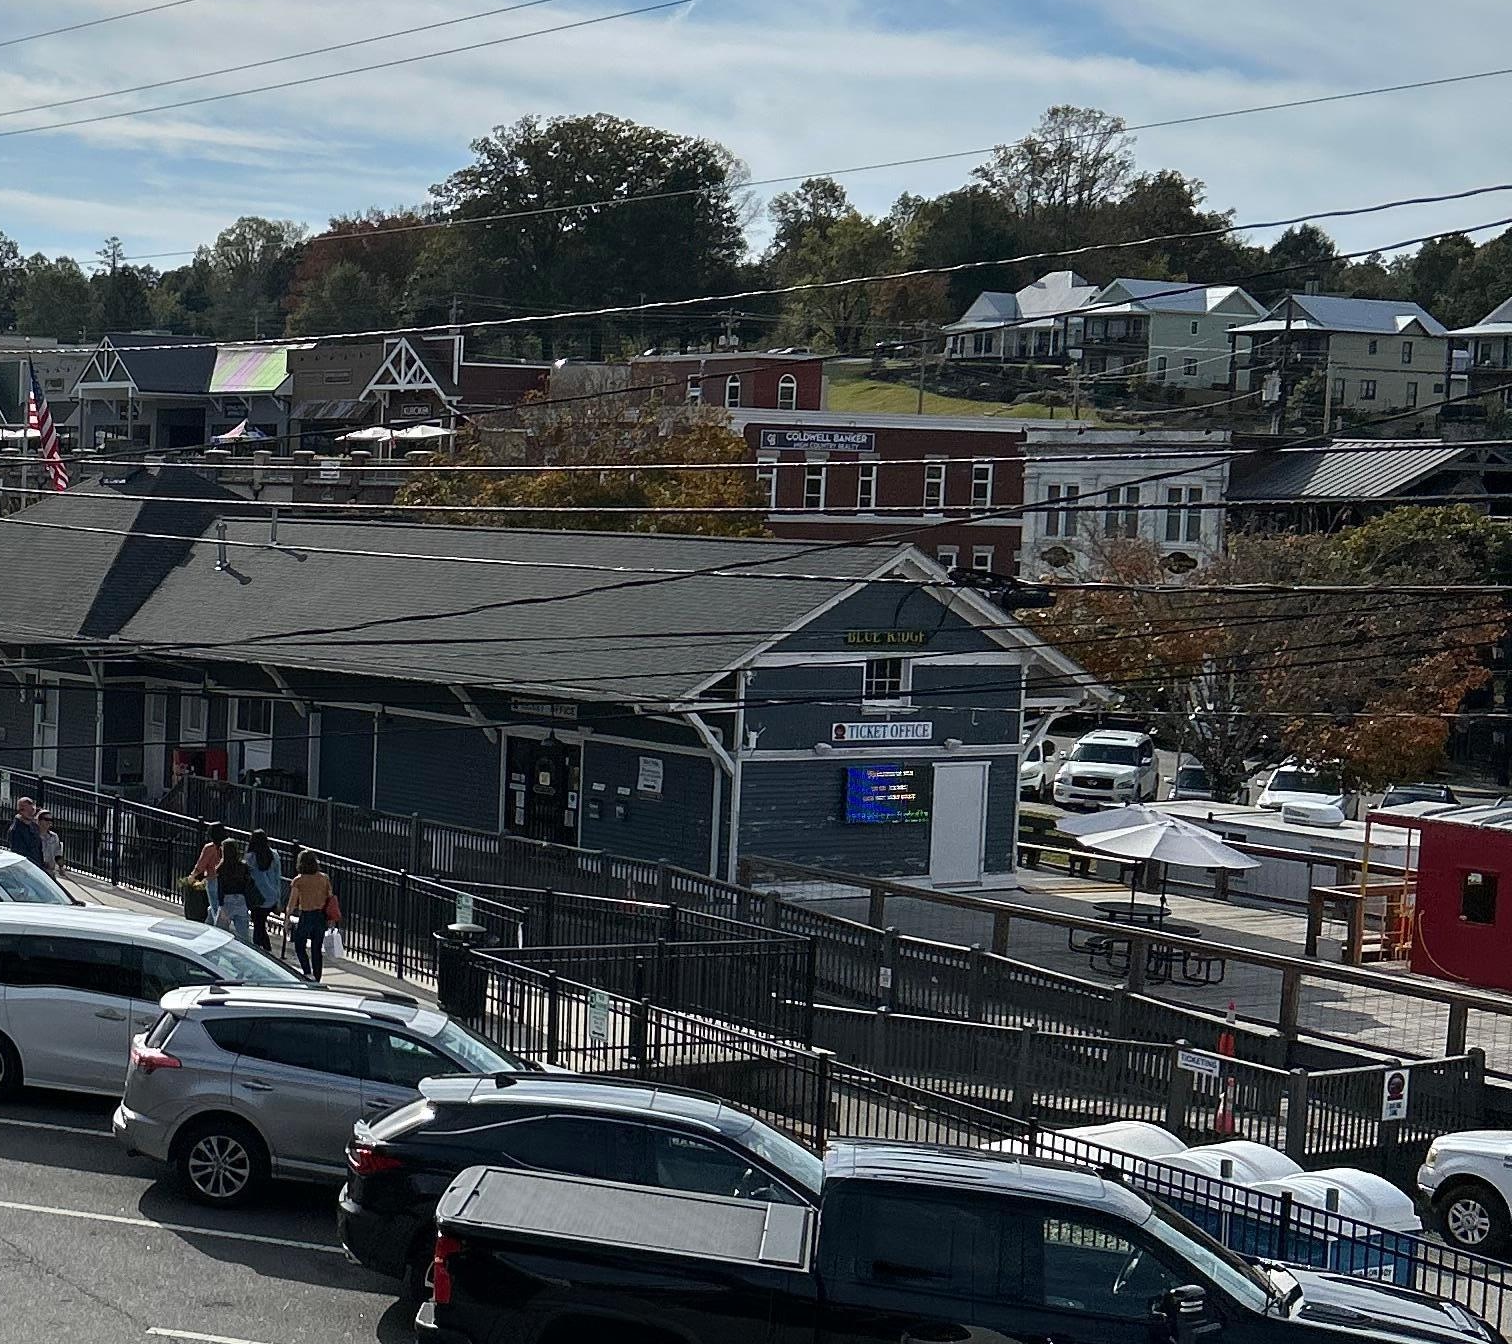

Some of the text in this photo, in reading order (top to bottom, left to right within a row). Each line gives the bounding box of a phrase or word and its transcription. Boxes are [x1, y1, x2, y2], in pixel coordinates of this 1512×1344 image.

[786, 432, 868, 444] COLDWELL BANKER
[848, 723, 930, 739] TICKET OFFICE
